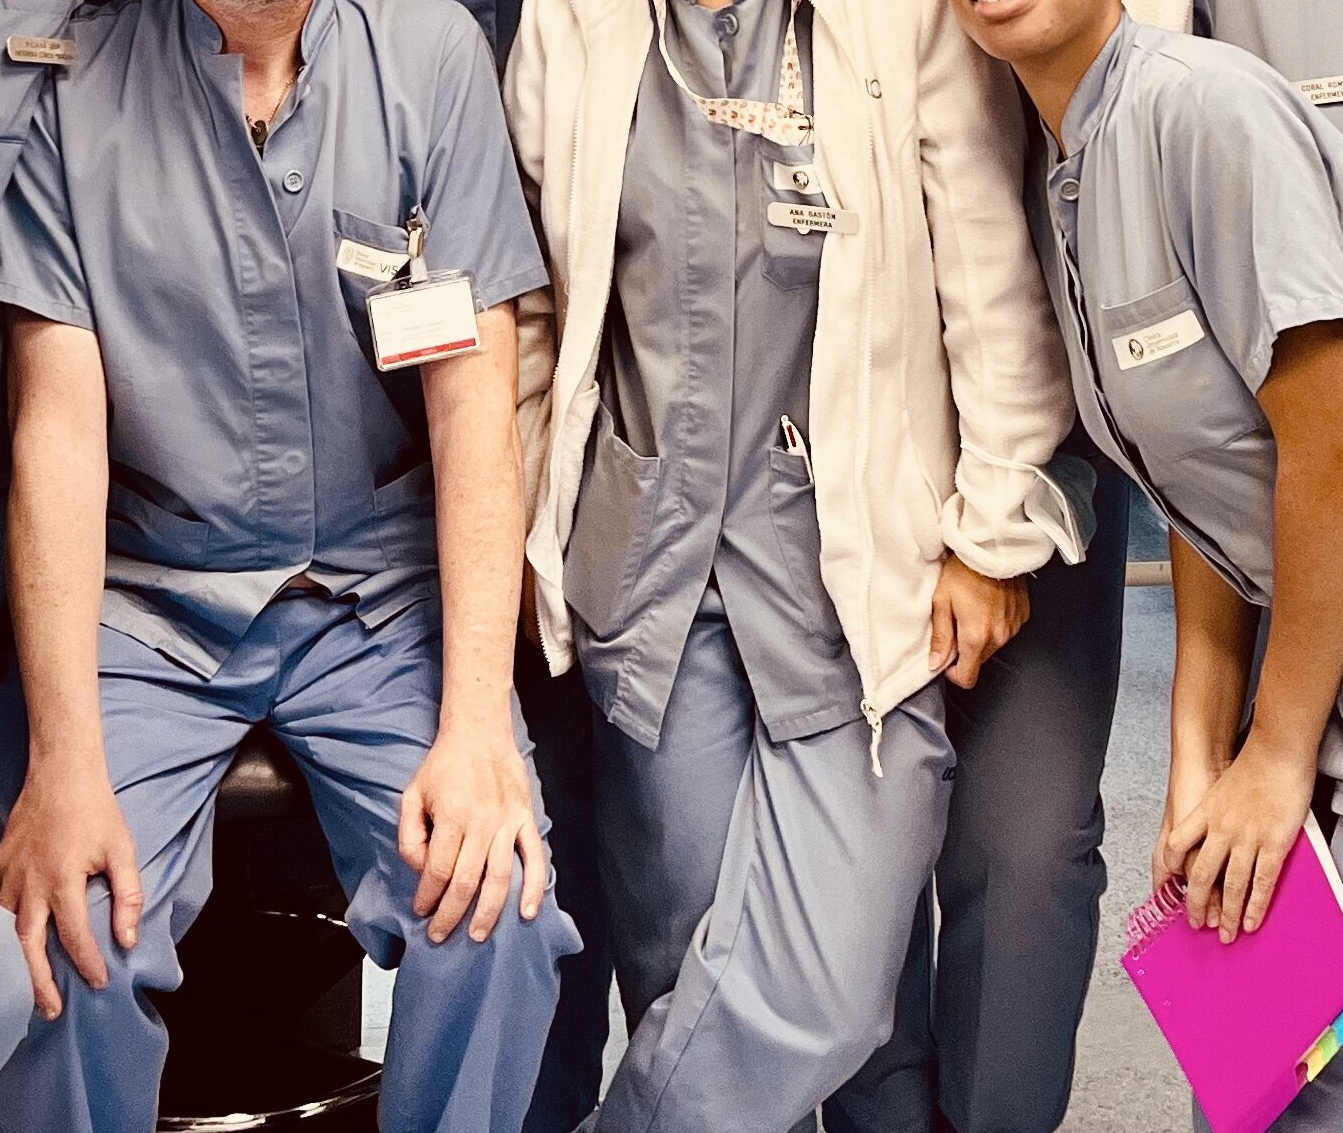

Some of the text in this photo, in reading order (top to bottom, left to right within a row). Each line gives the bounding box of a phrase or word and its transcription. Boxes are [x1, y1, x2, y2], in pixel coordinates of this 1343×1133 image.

[1301, 84, 1324, 92] CORAL
[792, 218, 833, 228] ENFERMERA
[380, 262, 399, 276] VIS
